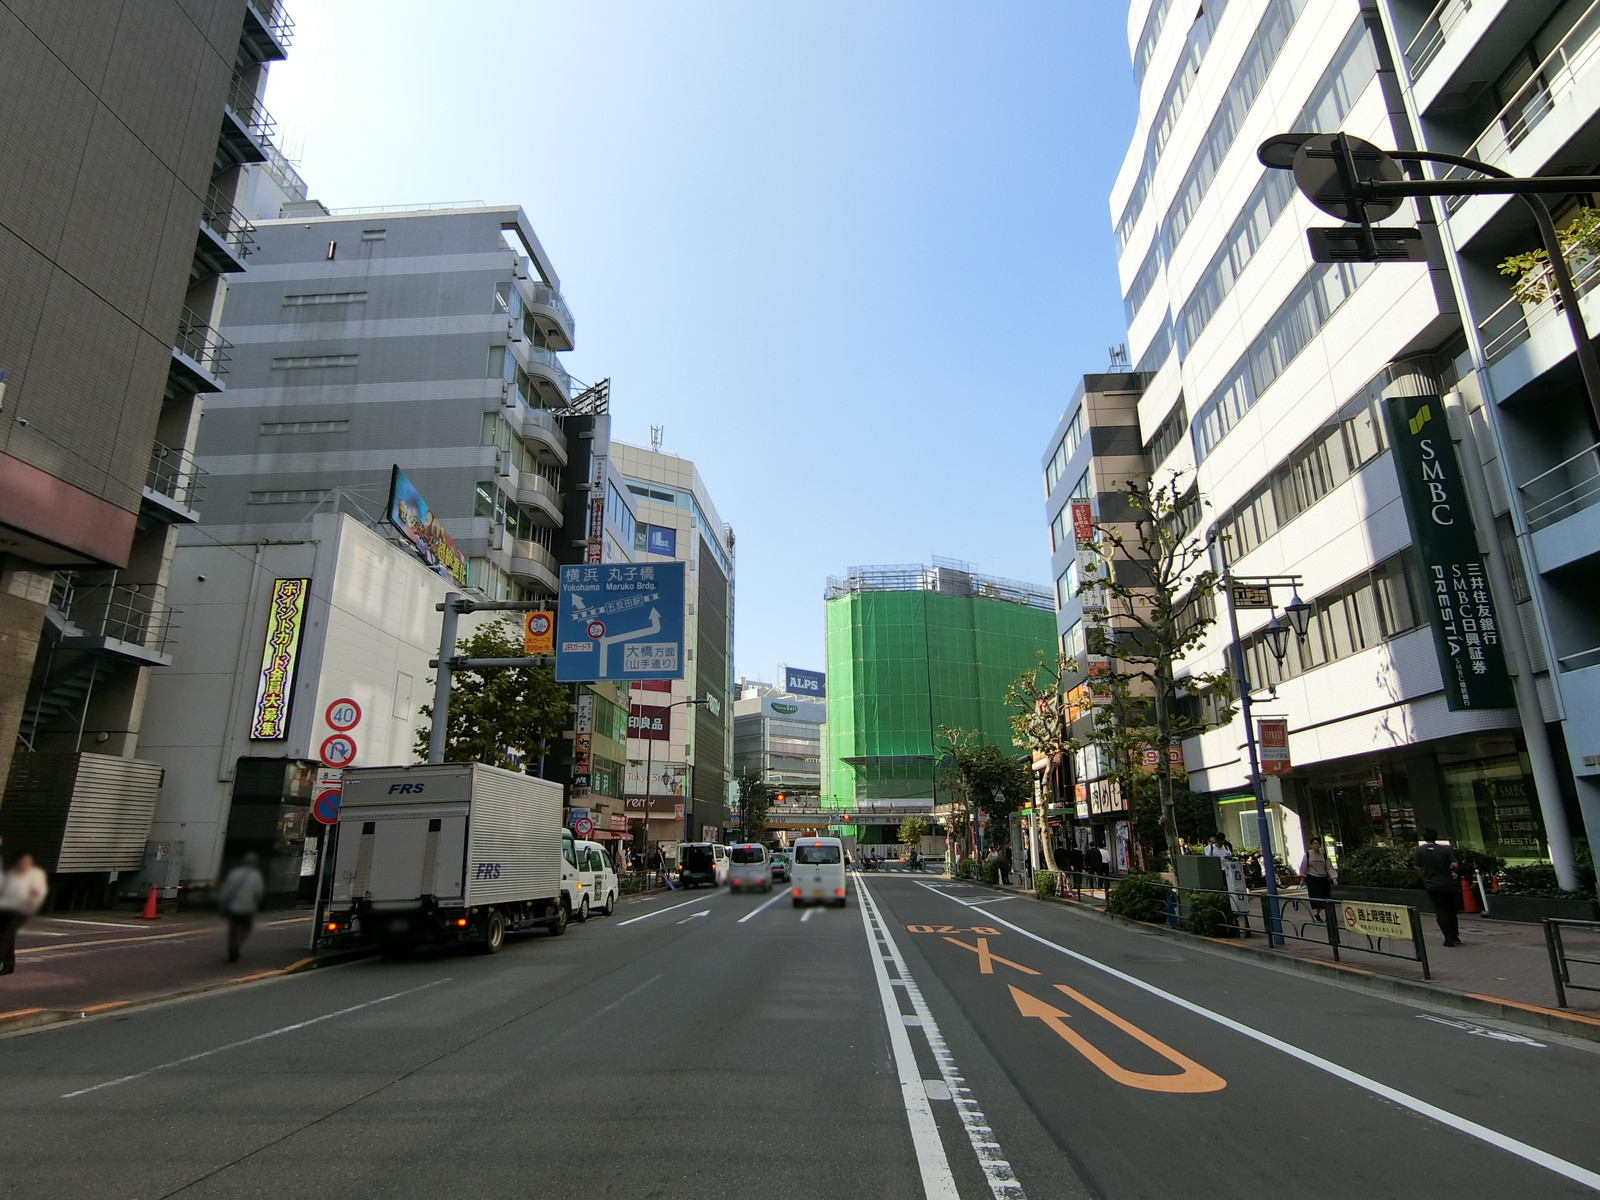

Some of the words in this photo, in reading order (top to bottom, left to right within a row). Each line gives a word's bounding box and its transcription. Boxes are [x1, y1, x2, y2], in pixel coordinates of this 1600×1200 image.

[1420, 439, 1453, 525] SMBC
[564, 568, 598, 582] 横浜
[608, 566, 655, 581] 丸子橋
[563, 584, 600, 592] Yokohama
[605, 582, 635, 591] Maruko
[636, 581, 657, 592] Brdg.
[607, 597, 643, 612] 五反田駅
[1466, 563, 1497, 645] 三井住友銀行
[1451, 564, 1487, 675] SMBC日興証券
[563, 643, 592, 651] JRガード下
[626, 646, 676, 658] 大橋方面
[260, 582, 299, 736] ポイントカード会員大募集
[625, 659, 677, 670] (山手通り)
[789, 677, 819, 690] ALPS
[333, 708, 354, 722] 40
[579, 705, 588, 726] すみれ
[628, 716, 663, 730] 印良品
[627, 773, 650, 782] Toky
[652, 773, 673, 782] Stoe
[388, 783, 424, 794] FRS
[1498, 837, 1540, 845] PRESTIA
[476, 863, 501, 880] FRS
[1357, 908, 1401, 926] 路上喫煙禁止
